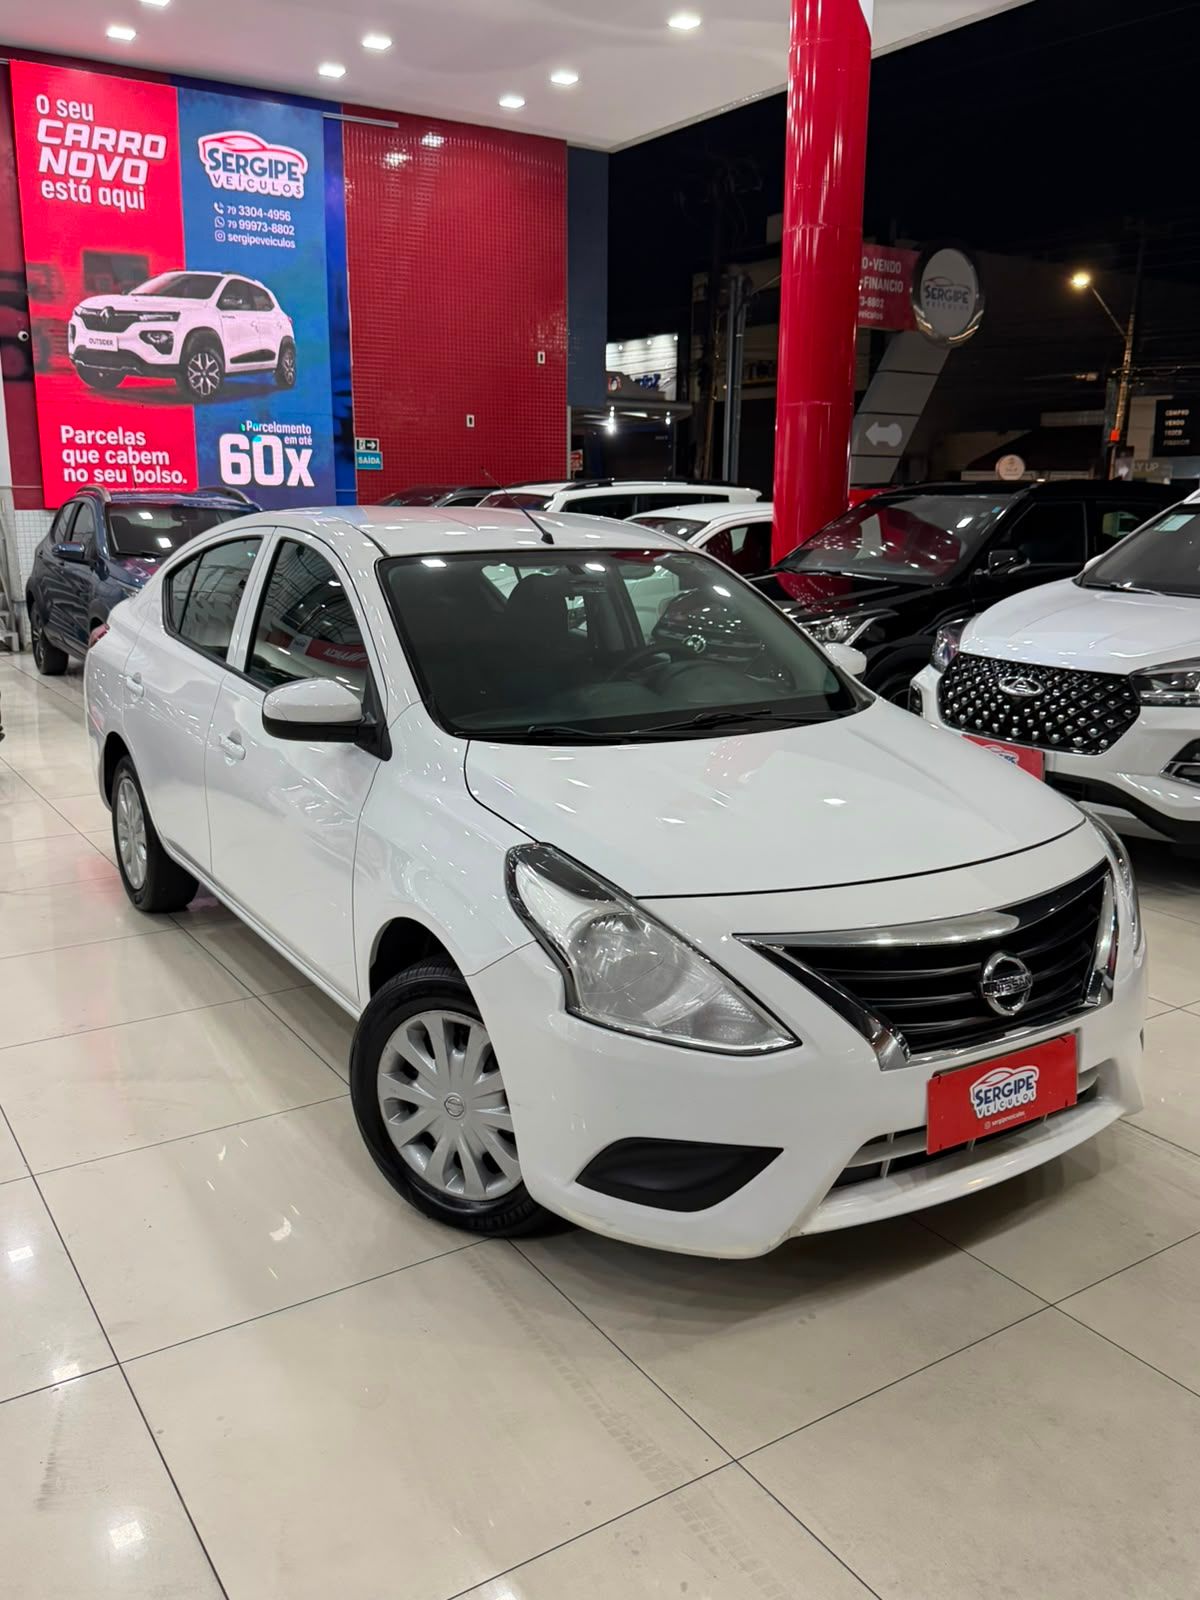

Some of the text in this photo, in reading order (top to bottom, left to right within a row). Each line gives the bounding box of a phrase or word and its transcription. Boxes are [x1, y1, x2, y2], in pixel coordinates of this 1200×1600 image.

[36, 94, 94, 121] O seu
[37, 118, 167, 160] CARRO
[38, 146, 149, 184] NOVO
[206, 147, 300, 182] SERGIPE
[211, 172, 304, 197] VEÍCULOS
[41, 178, 146, 213] está aqui
[238, 205, 292, 222] 3304-4956
[227, 219, 295, 236] 79 99973-8802
[227, 233, 296, 249] sergipeveiculos
[924, 285, 968, 304] SERGIPE
[88, 337, 114, 346] OUTSIDER
[60, 424, 146, 445] Parcelas
[246, 420, 312, 436] Parcelamento
[284, 434, 313, 446] em até
[62, 445, 170, 468] que cabem
[218, 432, 315, 487] 60x
[358, 455, 381, 465] SAÍDA
[63, 465, 188, 485] no seu bolso.
[988, 974, 1032, 994] NISSAN
[974, 1074, 1035, 1107] SERGIPE
